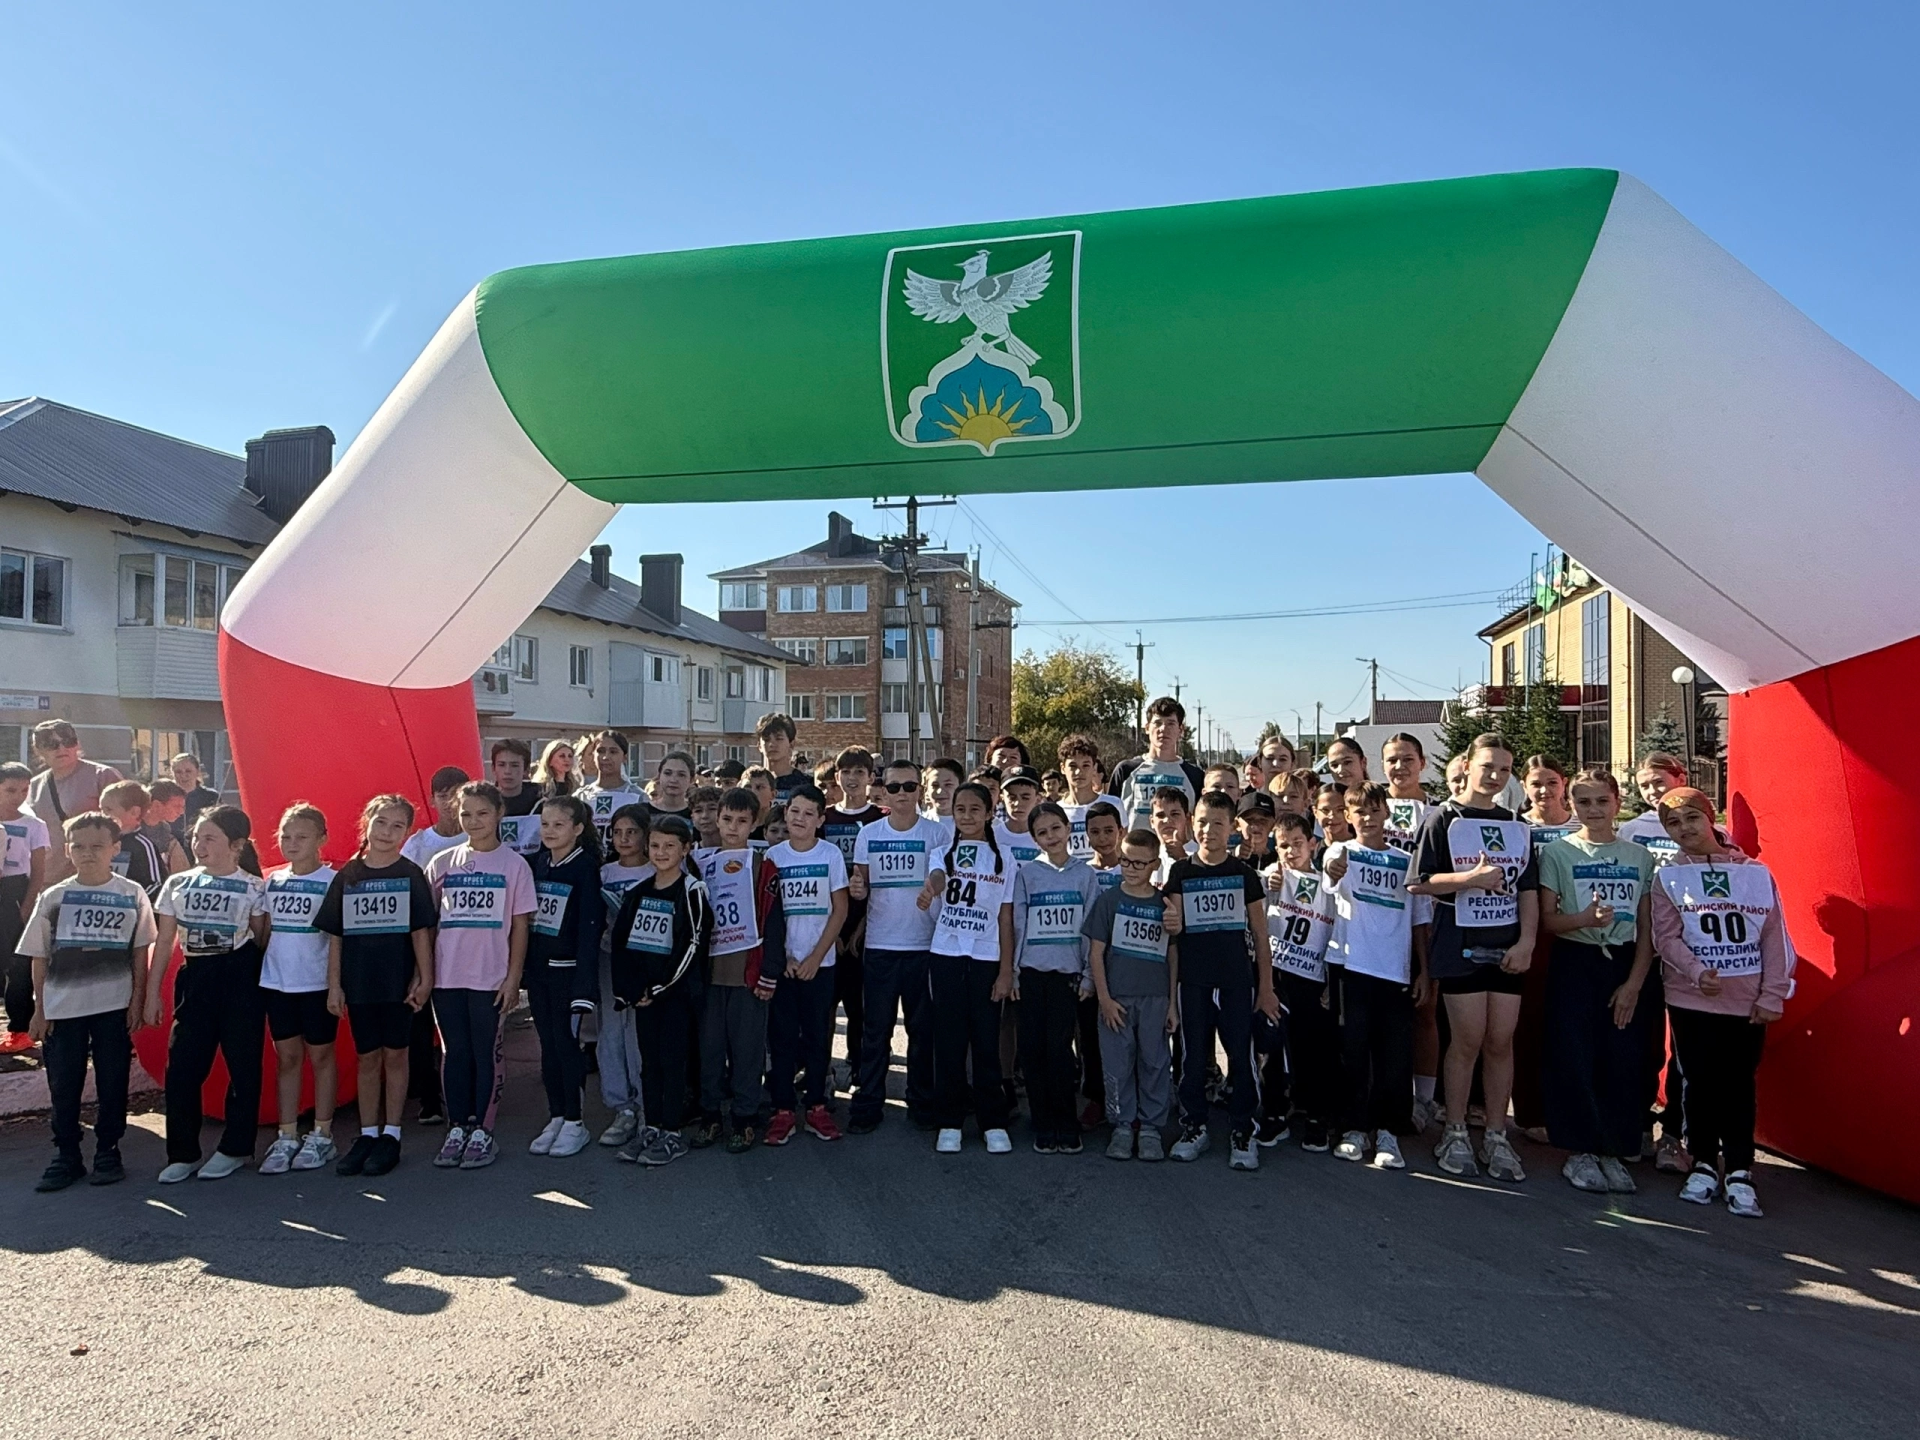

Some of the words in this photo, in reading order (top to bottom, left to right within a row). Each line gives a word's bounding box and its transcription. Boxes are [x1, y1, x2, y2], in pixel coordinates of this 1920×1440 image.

[836, 838, 857, 853] 137
[1068, 835, 1091, 850] 131
[879, 854, 915, 871] 13119
[1454, 856, 1514, 865] ЮТАЗНСКИЙ
[951, 870, 977, 880] НСКИЙ
[979, 874, 1005, 886] РАЙОН
[1359, 866, 1398, 890] 13910
[452, 890, 495, 909] 13628
[780, 880, 819, 899] 13244
[945, 878, 977, 908] 84
[183, 891, 231, 912] 13521
[272, 895, 312, 915] 13239
[353, 895, 398, 916] 13419
[538, 896, 559, 916] 736
[1193, 893, 1235, 913] 13970
[1279, 901, 1315, 918] ЗИНСКИЙ
[1468, 896, 1511, 906] РЕСПУБ
[1678, 902, 1738, 913] ТАЗИНСКИЙ
[73, 908, 126, 930] 13922
[716, 901, 740, 927] 38
[944, 906, 988, 921] ПУБЛИКА
[1036, 908, 1075, 926] 13107
[1473, 907, 1517, 920] ТАТАРСТ
[634, 913, 668, 935] 3676
[1123, 919, 1162, 943] 13569
[1283, 914, 1311, 946] 19
[1700, 911, 1747, 944] 90
[1271, 938, 1320, 962] СПУБЛИКА
[1271, 950, 1315, 972] ТАРСТАН
